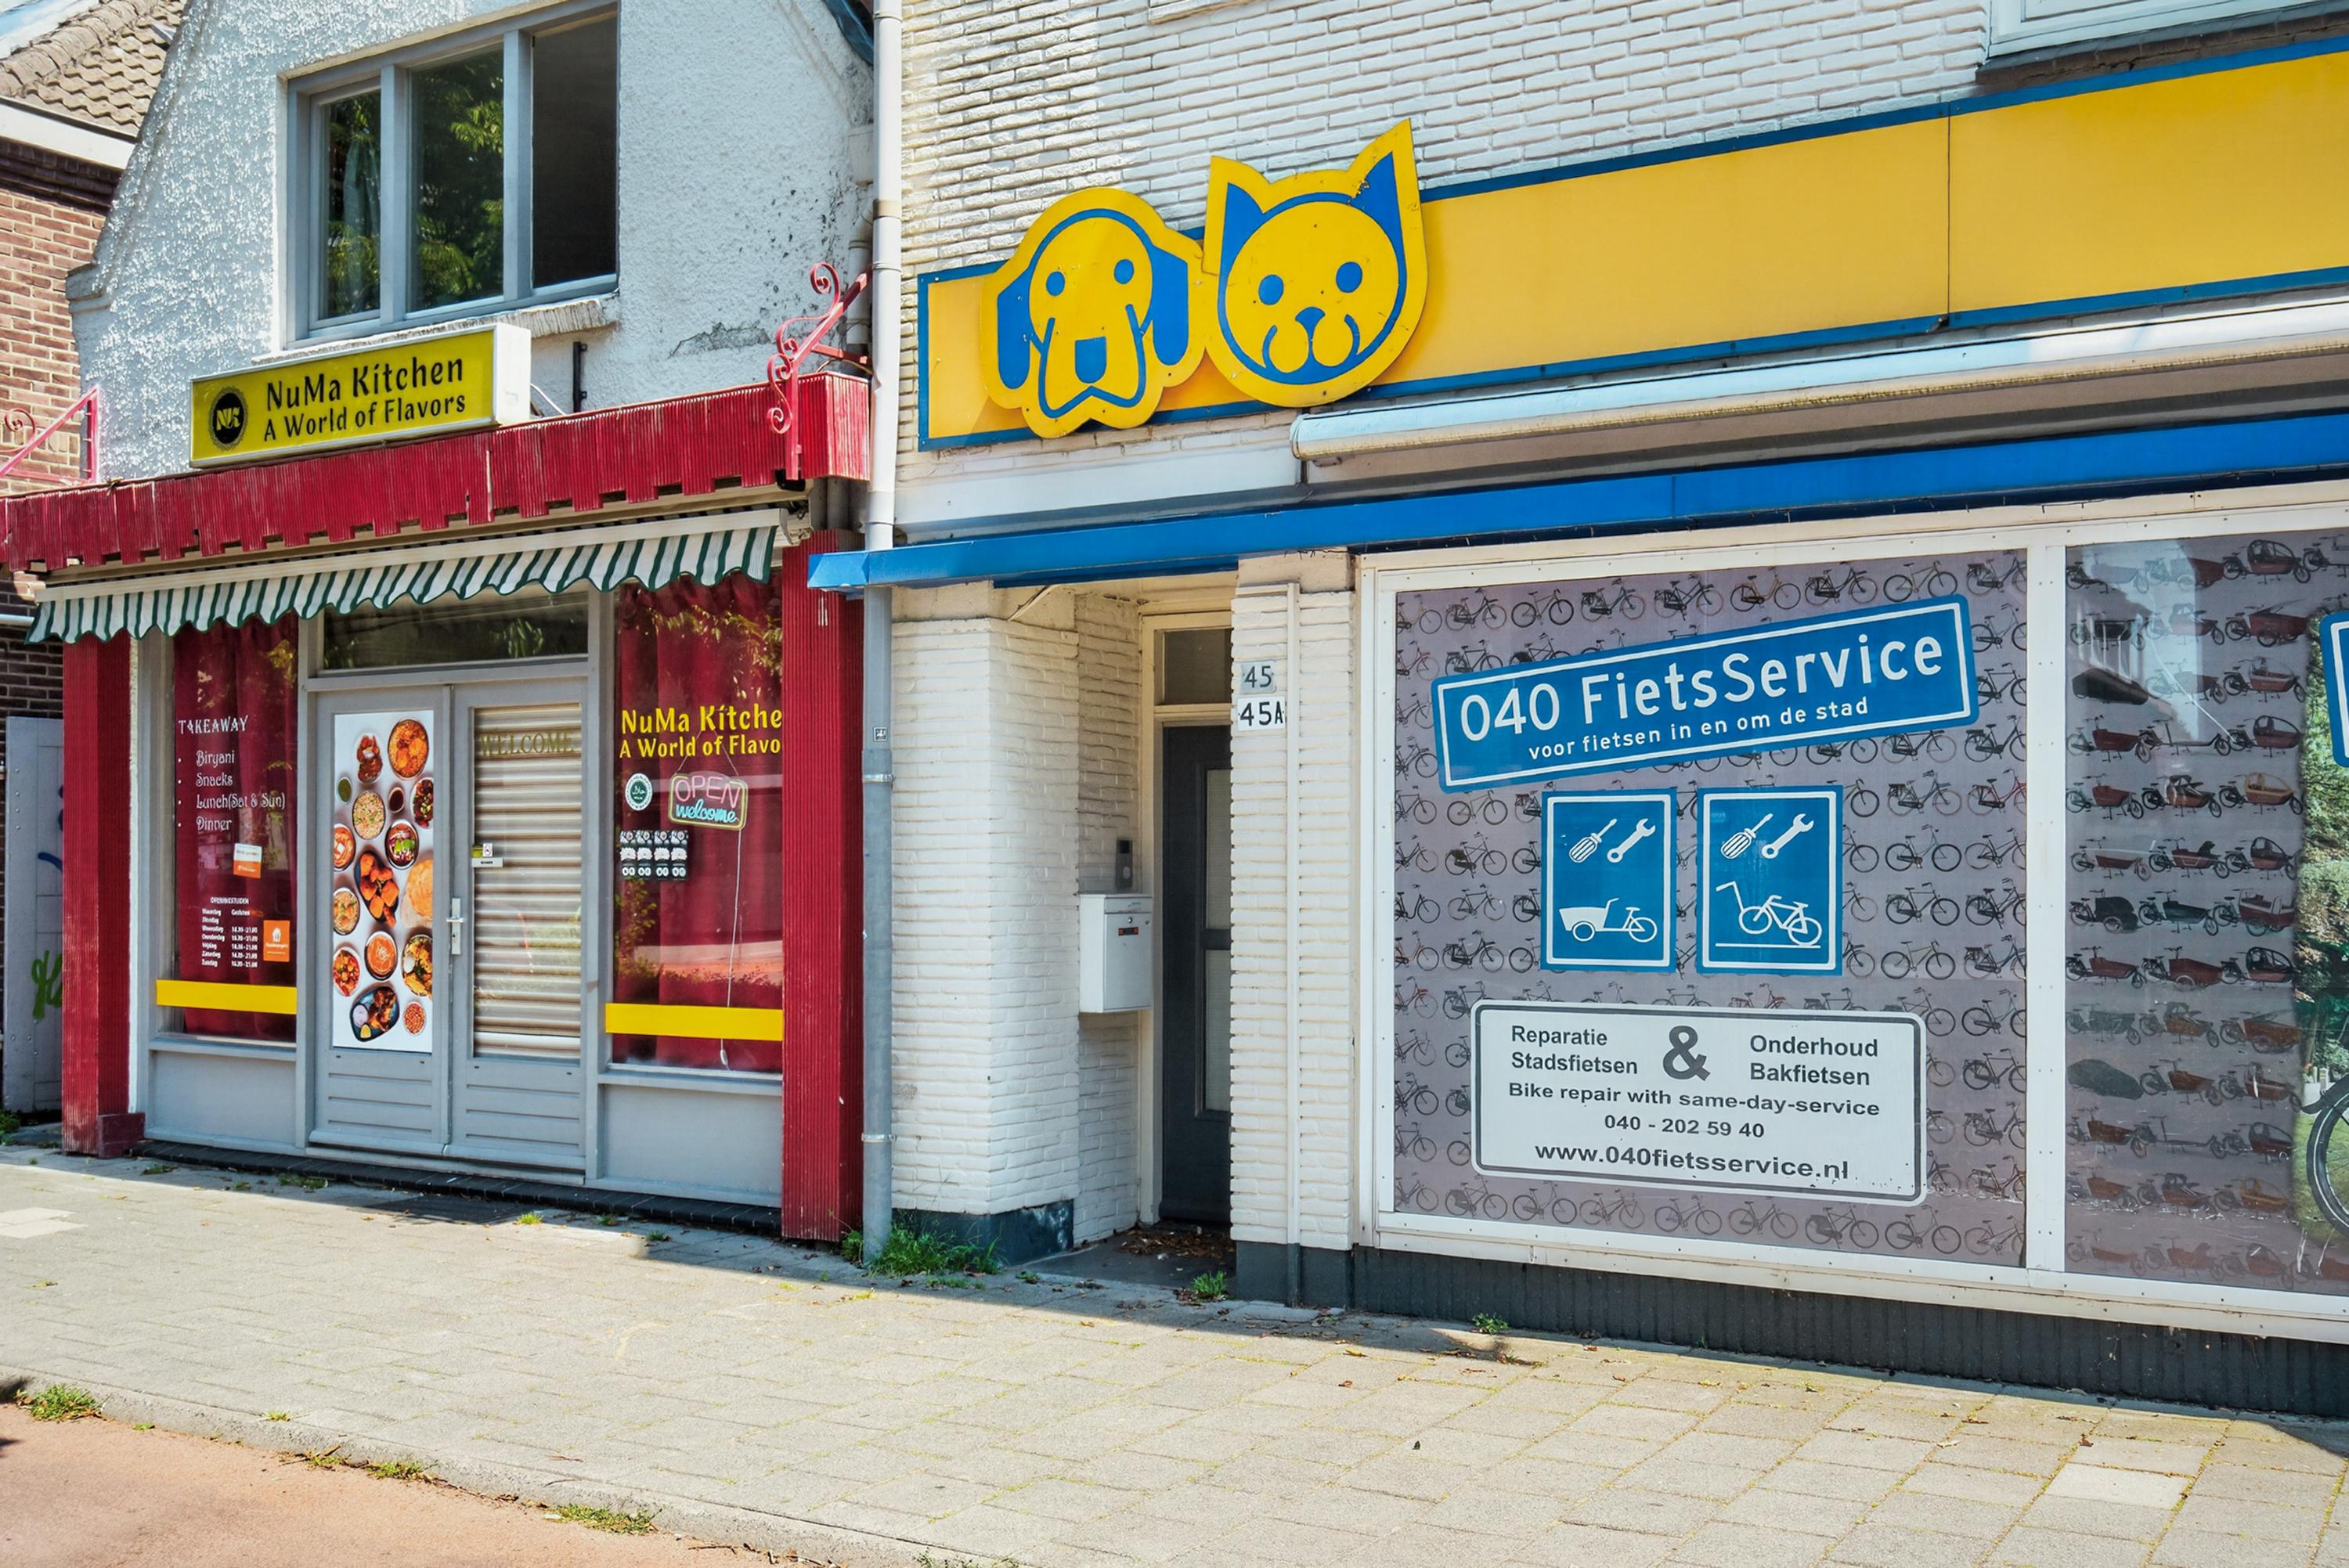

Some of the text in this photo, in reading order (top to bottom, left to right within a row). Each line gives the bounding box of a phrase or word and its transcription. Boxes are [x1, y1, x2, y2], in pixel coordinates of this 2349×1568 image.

[267, 356, 464, 411] NuMa Kitchen
[264, 395, 466, 442] A World of Flavors
[1244, 665, 1272, 688] 45
[1460, 633, 1943, 742] 040 FietsService
[178, 715, 249, 734] TAKEAWAY
[622, 707, 690, 734] NuMa
[1240, 701, 1283, 726] 45A
[1528, 696, 1868, 760] voor fietsen in en om de stad
[480, 729, 575, 756] WELCOME
[619, 739, 631, 759] A
[637, 737, 696, 758] World
[702, 735, 723, 755] of
[196, 750, 235, 768] Biryani
[196, 773, 233, 788] Snacks
[675, 775, 741, 808] OPEN
[251, 793, 258, 808] &
[676, 798, 738, 822] welcome
[197, 816, 233, 831] Dinner
[1511, 1026, 1607, 1047] Reparatie
[1750, 1035, 1878, 1057] Onderhoud
[1511, 1051, 1638, 1075] Stadsfietsen
[1662, 1026, 1711, 1081] &
[1750, 1062, 1870, 1086] Bakfietsen
[1509, 1083, 1880, 1116] Bike repair with same-day-service
[1604, 1115, 1641, 1130] 040
[1662, 1118, 1699, 1134] 202
[1707, 1121, 1732, 1136] 59
[1738, 1123, 1765, 1137] 40
[1535, 1145, 1848, 1180] www.040fietsservice.nl
